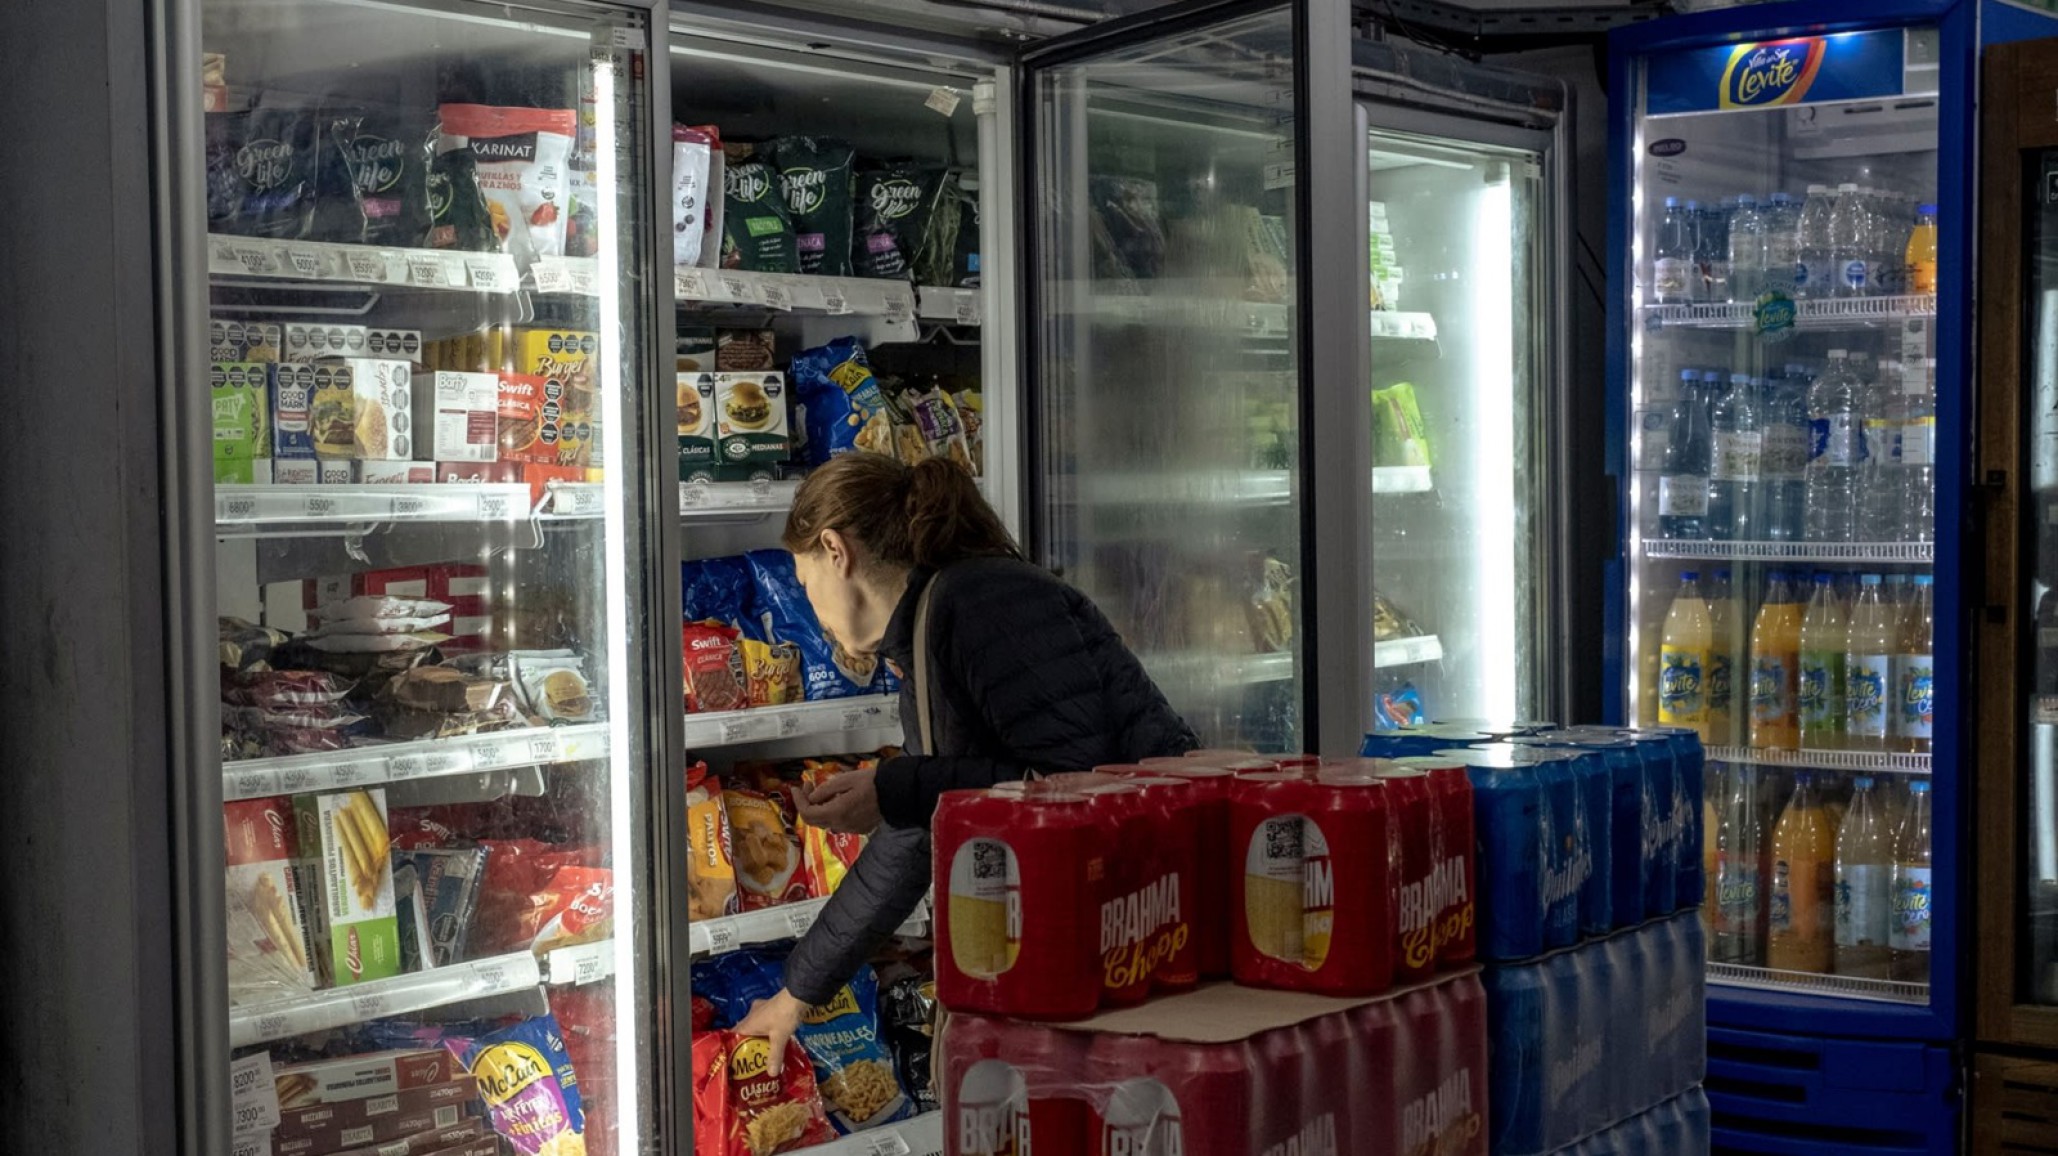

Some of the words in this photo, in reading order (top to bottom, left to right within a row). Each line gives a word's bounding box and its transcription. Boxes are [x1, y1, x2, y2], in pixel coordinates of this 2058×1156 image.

[236, 142, 295, 178] Green
[256, 160, 285, 188] life
[357, 161, 392, 192] life
[740, 176, 764, 202] life
[790, 187, 817, 215] life
[871, 182, 922, 209] Green
[438, 373, 468, 392] Barfy
[536, 355, 586, 383] Burger
[280, 390, 306, 401] GOOD
[497, 381, 534, 397] Swift
[280, 400, 305, 409] MARK
[324, 470, 349, 479] GOOD
[691, 636, 721, 651] Swift
[751, 658, 792, 683] Burger
[808, 672, 828, 682] 600
[1400, 855, 1467, 935] BRAHMA
[1101, 872, 1180, 955] BRAHMA
[1402, 902, 1474, 969] Chopp
[1104, 922, 1189, 989] Chopp
[478, 1055, 543, 1098] McCain
[236, 1106, 258, 1124] 7300
[1404, 1067, 1471, 1149] BRAHMA
